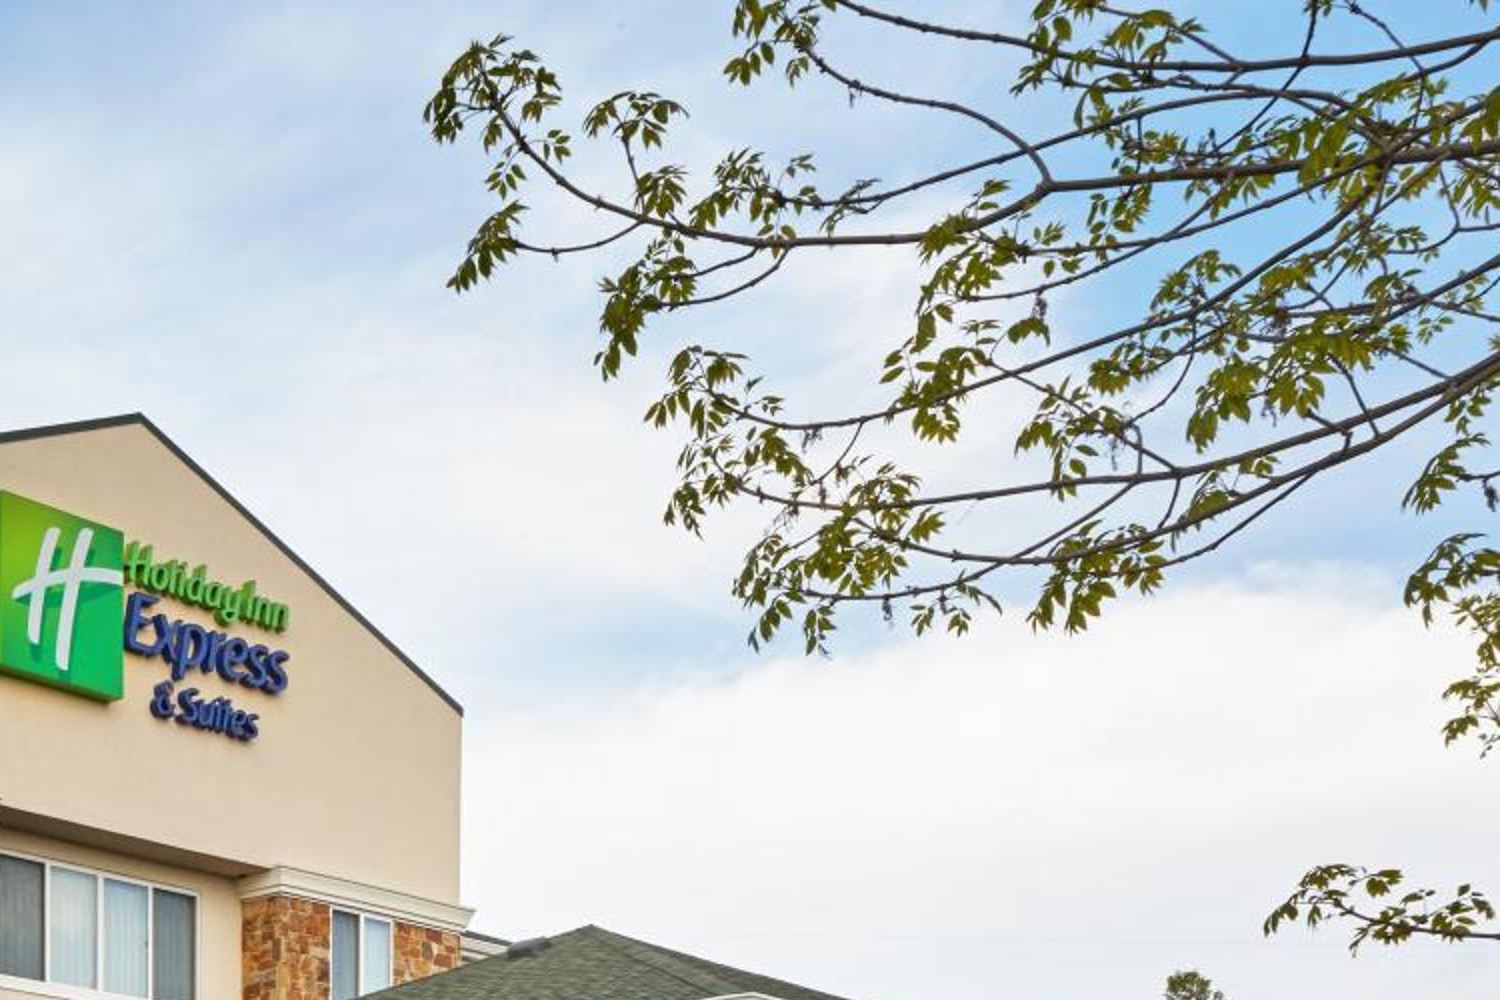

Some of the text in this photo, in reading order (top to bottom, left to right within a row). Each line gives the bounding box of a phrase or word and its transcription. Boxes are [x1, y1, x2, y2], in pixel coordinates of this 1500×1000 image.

[124, 540, 290, 633] Holiday Inn
[124, 591, 290, 695] Express
[150, 680, 260, 742] & Suites
